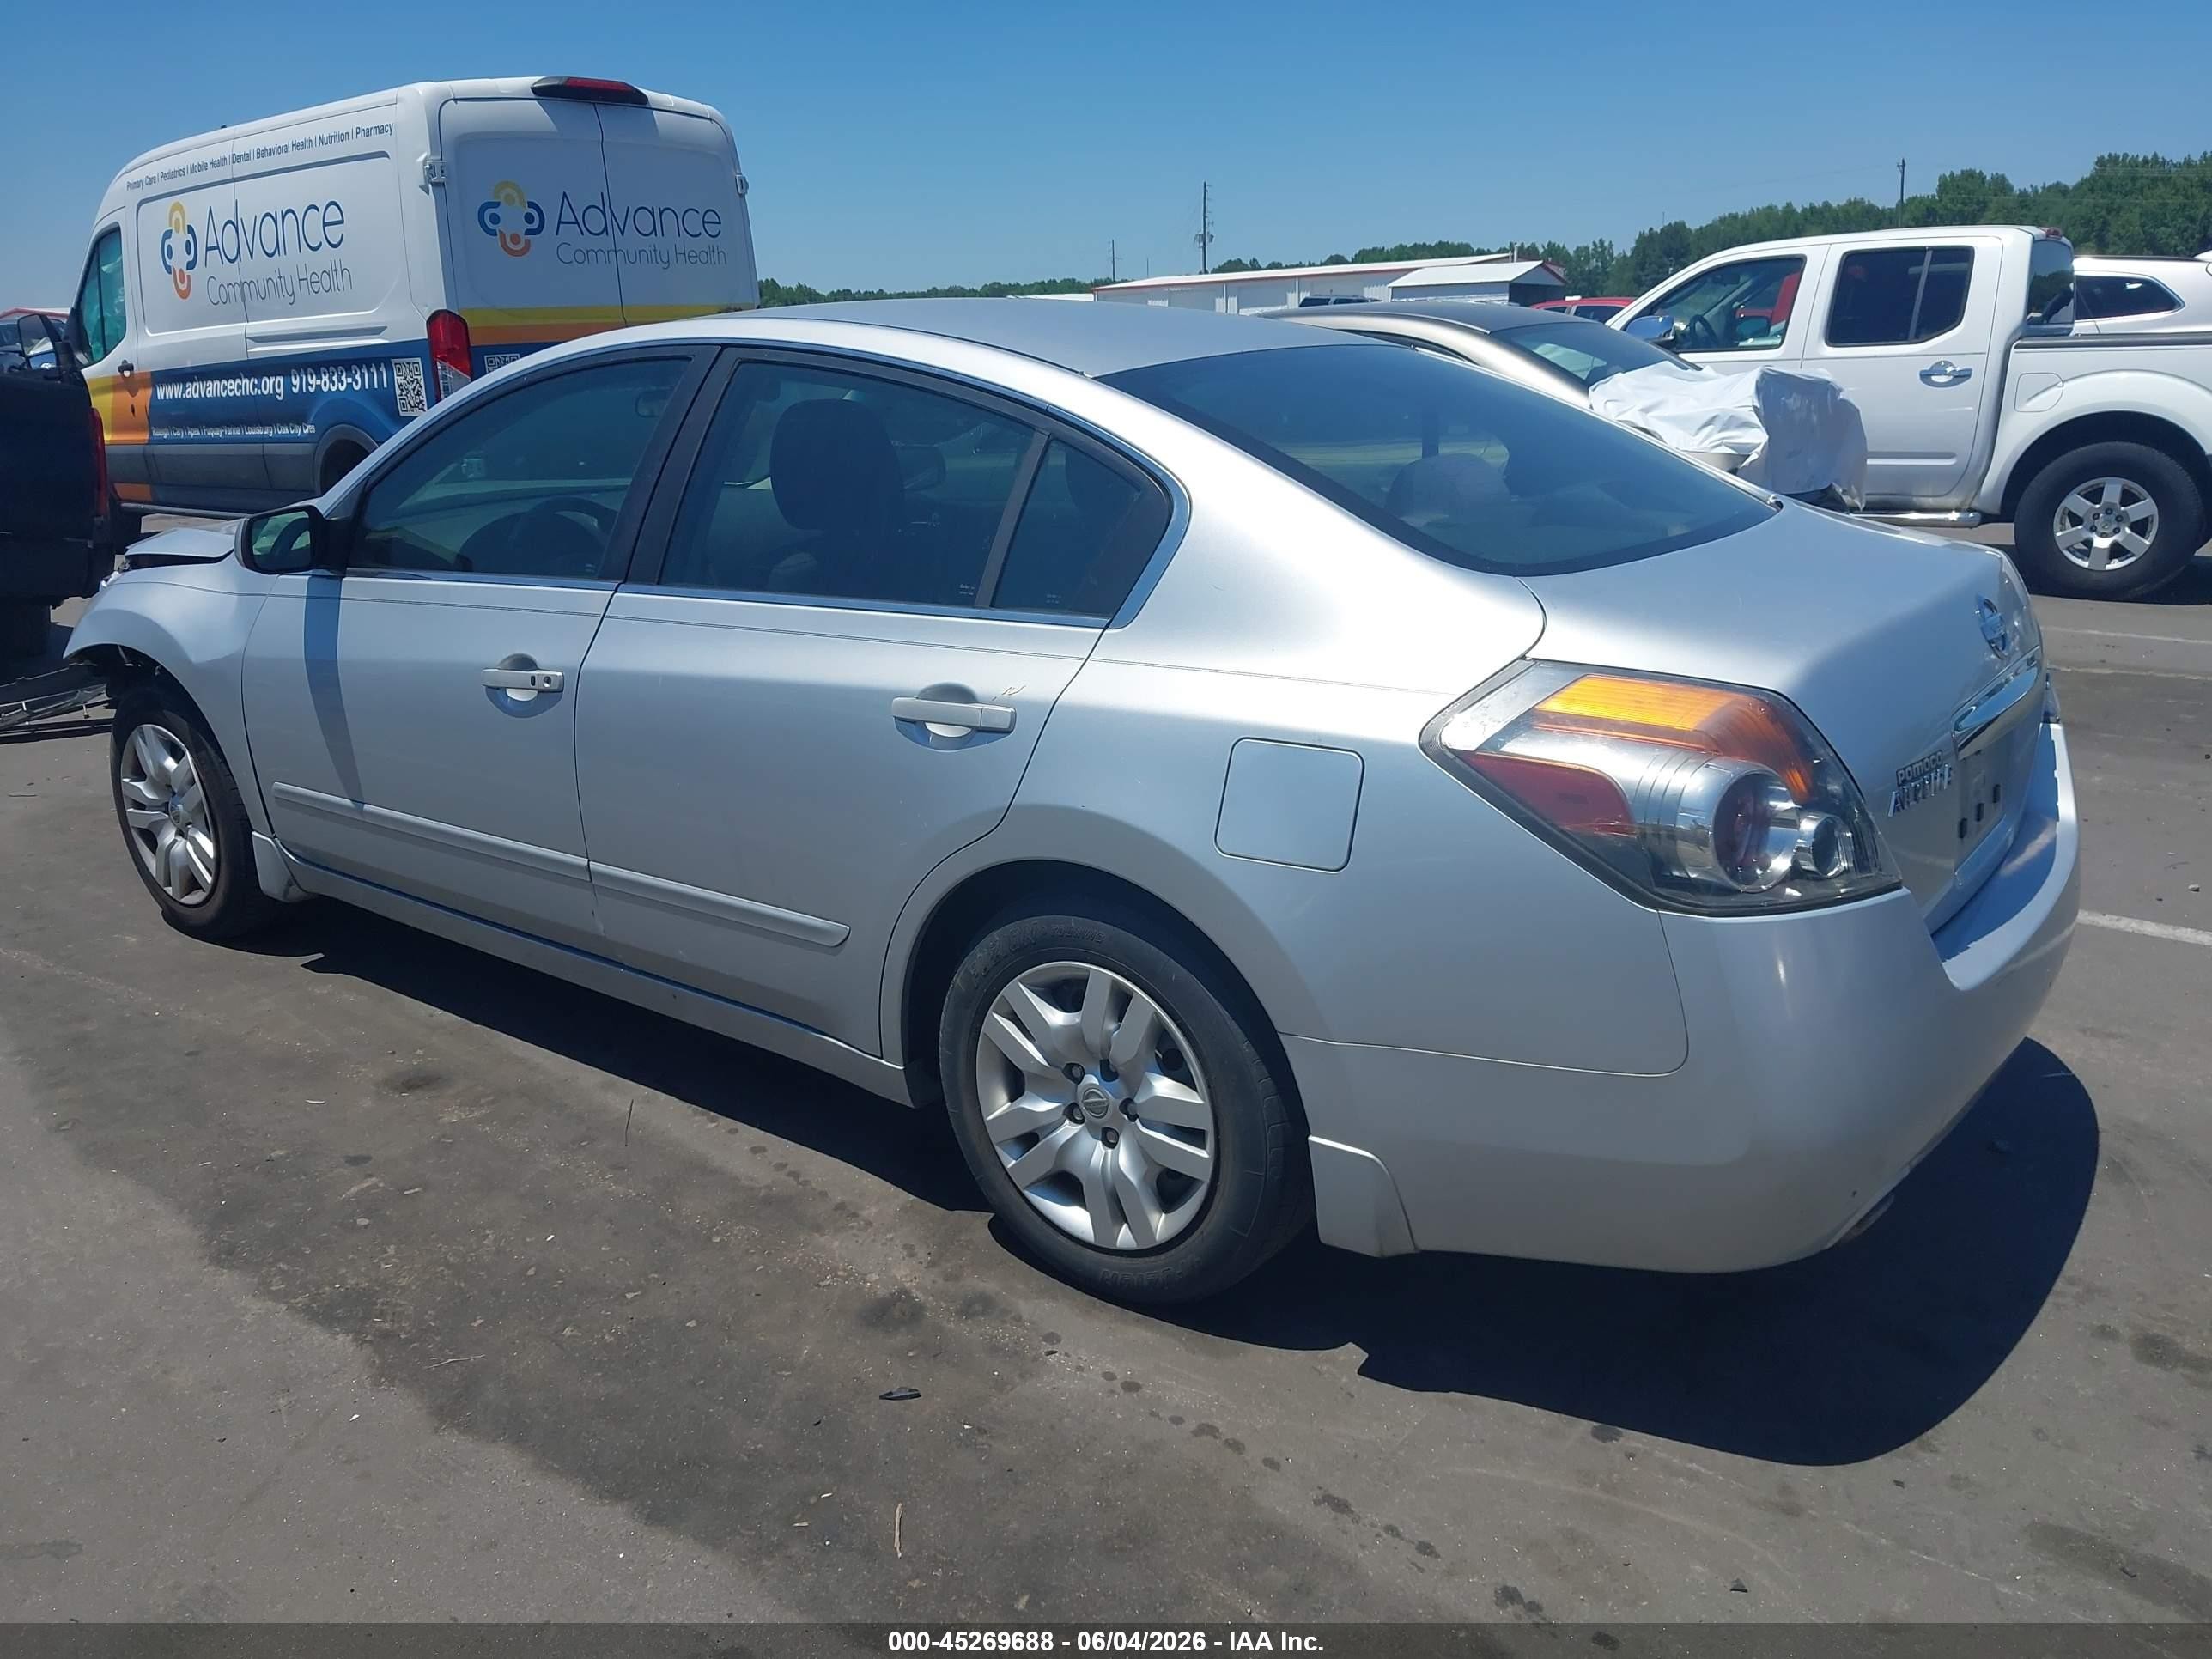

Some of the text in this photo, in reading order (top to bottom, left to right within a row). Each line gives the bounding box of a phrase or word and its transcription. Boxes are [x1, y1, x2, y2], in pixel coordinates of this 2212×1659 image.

[144, 174, 156, 186] Care
[160, 167, 185, 182] Pediatrics
[190, 160, 208, 175] Mobile
[209, 155, 228, 171] Health
[232, 151, 252, 165] Dental
[256, 143, 290, 159] Behavioral
[291, 137, 313, 152] Health
[319, 130, 349, 147] Nutrition
[356, 122, 393, 140] Pharmacy
[204, 199, 345, 268] Advance
[555, 191, 722, 238] Advance
[556, 242, 727, 270] Community Health
[206, 258, 353, 307] Community Health
[155, 362, 388, 401] www.advancechc.org 919-833-3111
